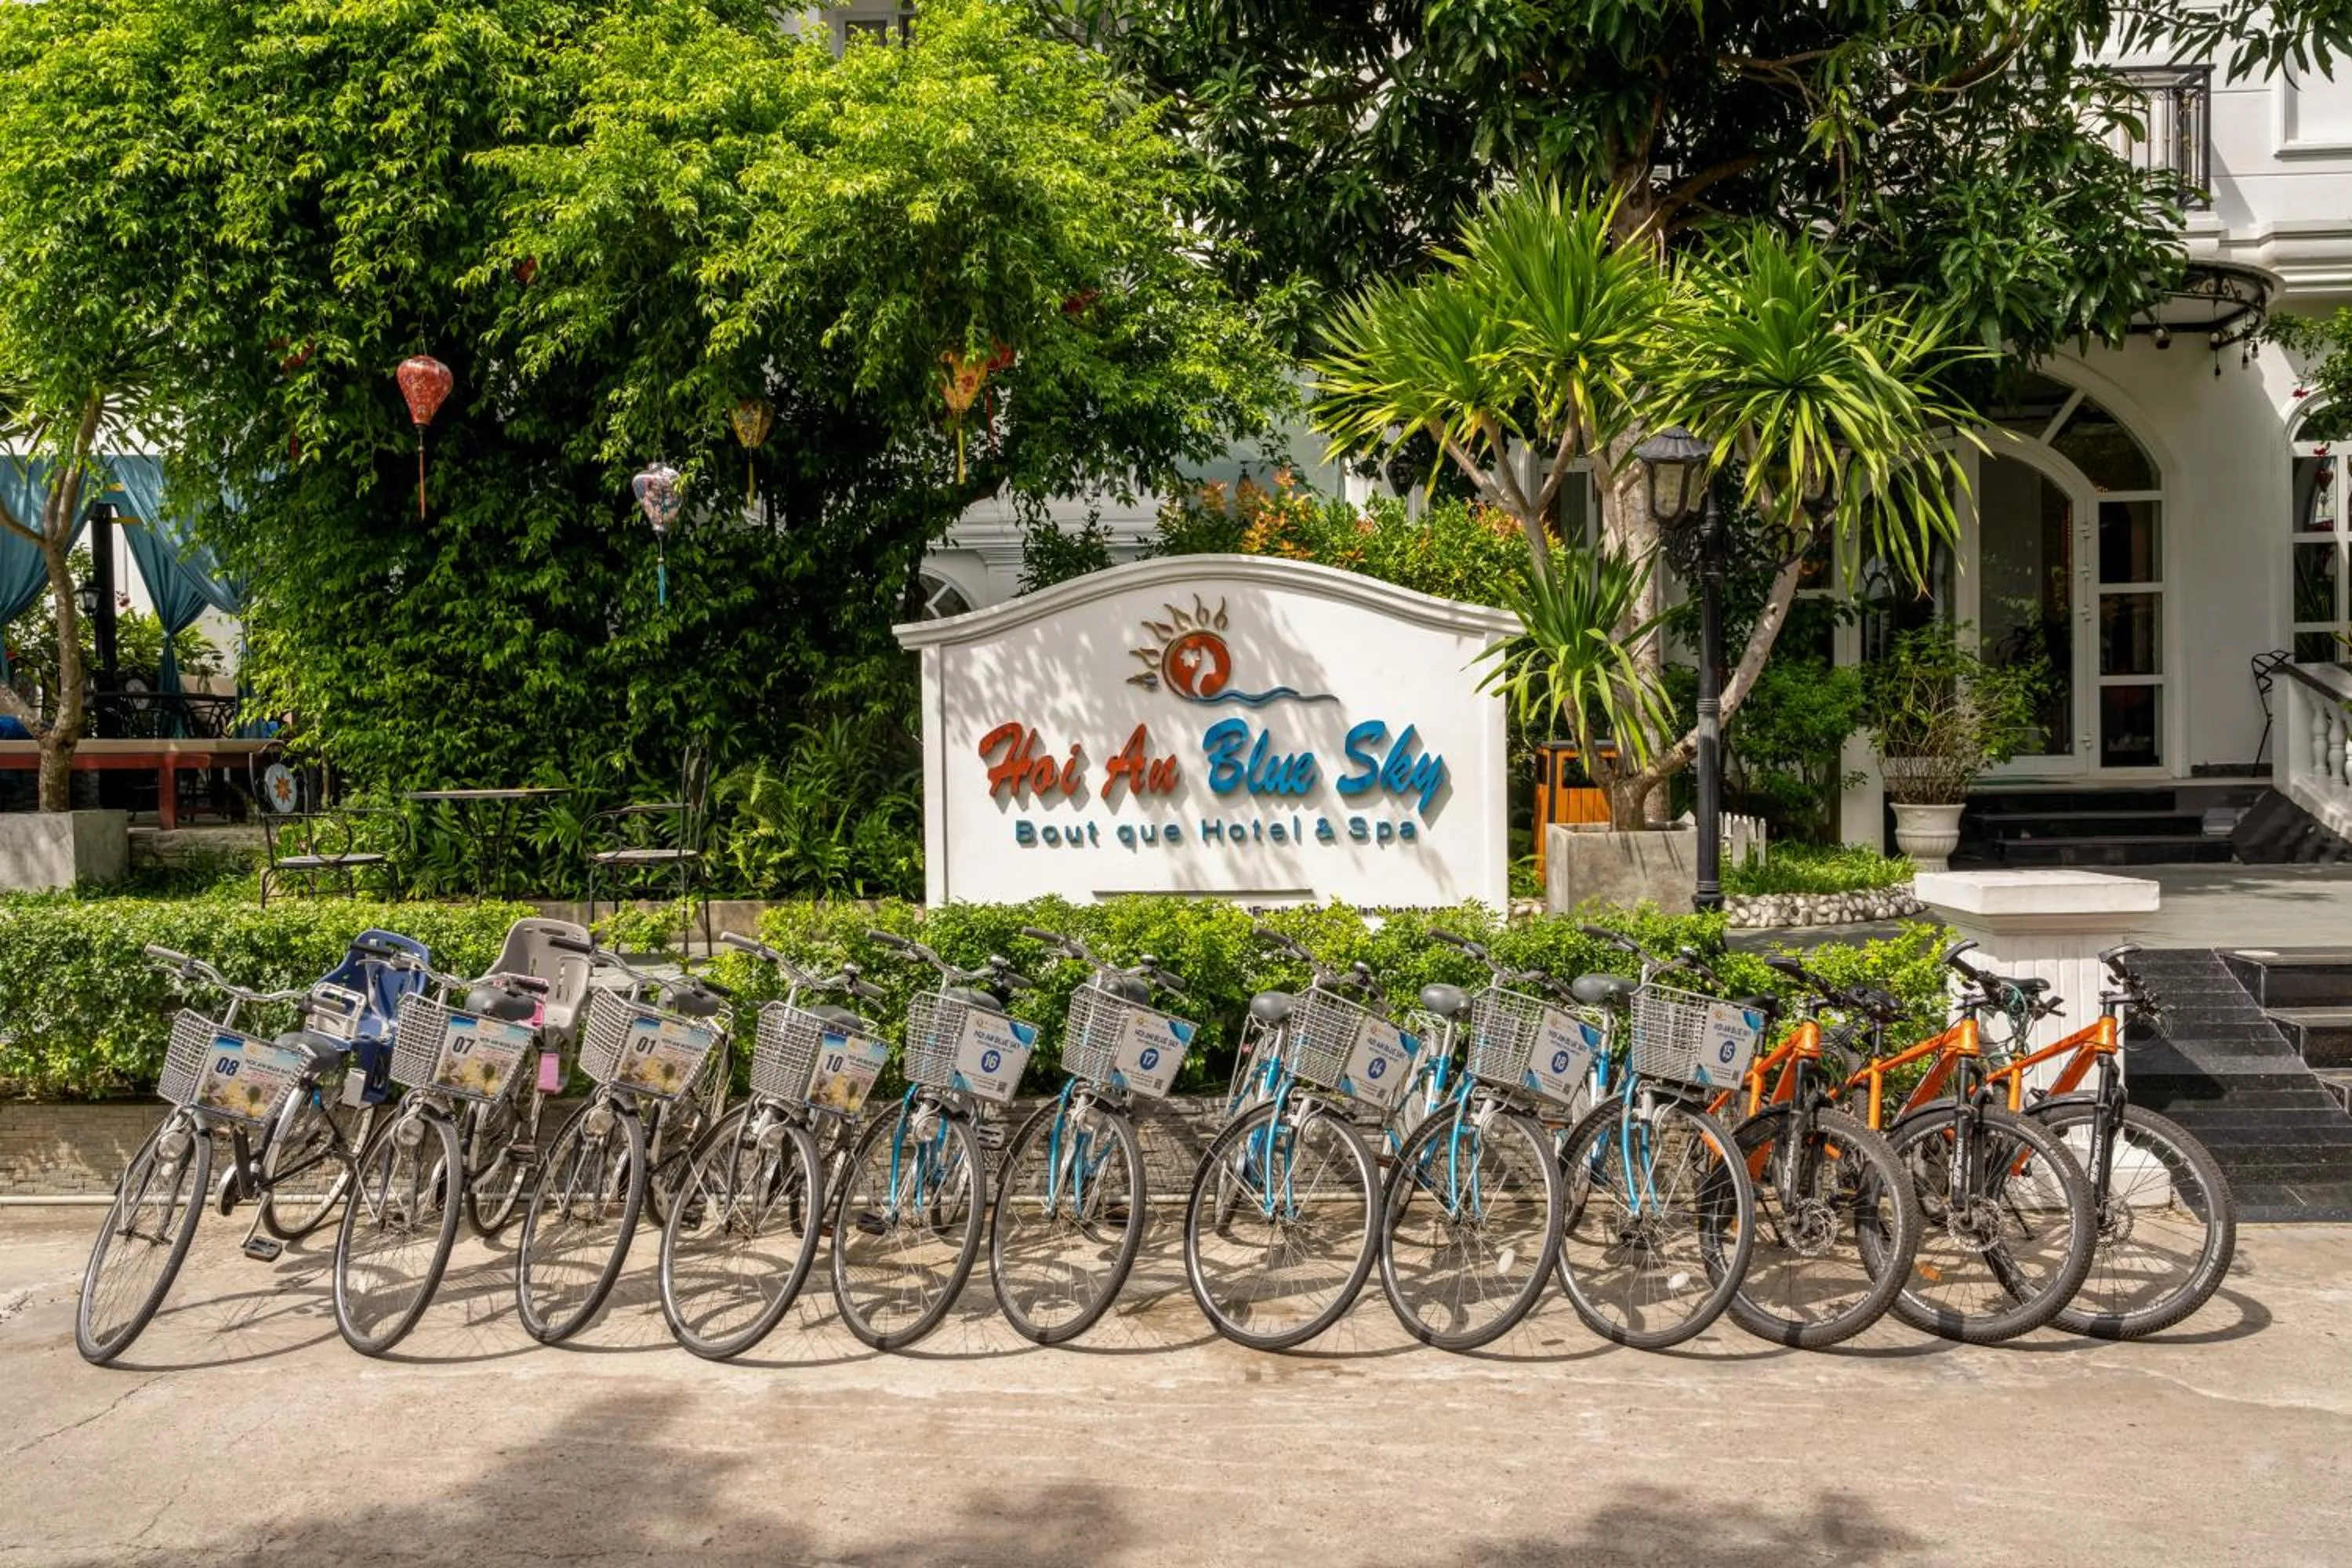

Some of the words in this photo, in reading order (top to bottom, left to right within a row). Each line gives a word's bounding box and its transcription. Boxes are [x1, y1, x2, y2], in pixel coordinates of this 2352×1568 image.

[978, 721, 1083, 797] Hoi
[1101, 723, 1180, 800] An
[1202, 717, 1318, 794] Blue
[1337, 719, 1444, 813] Sky
[1201, 815, 1301, 844] Hotel
[1316, 817, 1334, 840] &
[1348, 816, 1417, 847] Spa
[452, 1036, 476, 1054] 07
[636, 1036, 657, 1054] 01
[1722, 1044, 1733, 1060] 15
[214, 1056, 241, 1076] 08
[825, 1053, 844, 1073] 10
[1142, 1051, 1156, 1066] 17
[1554, 1054, 1567, 1071] 18
